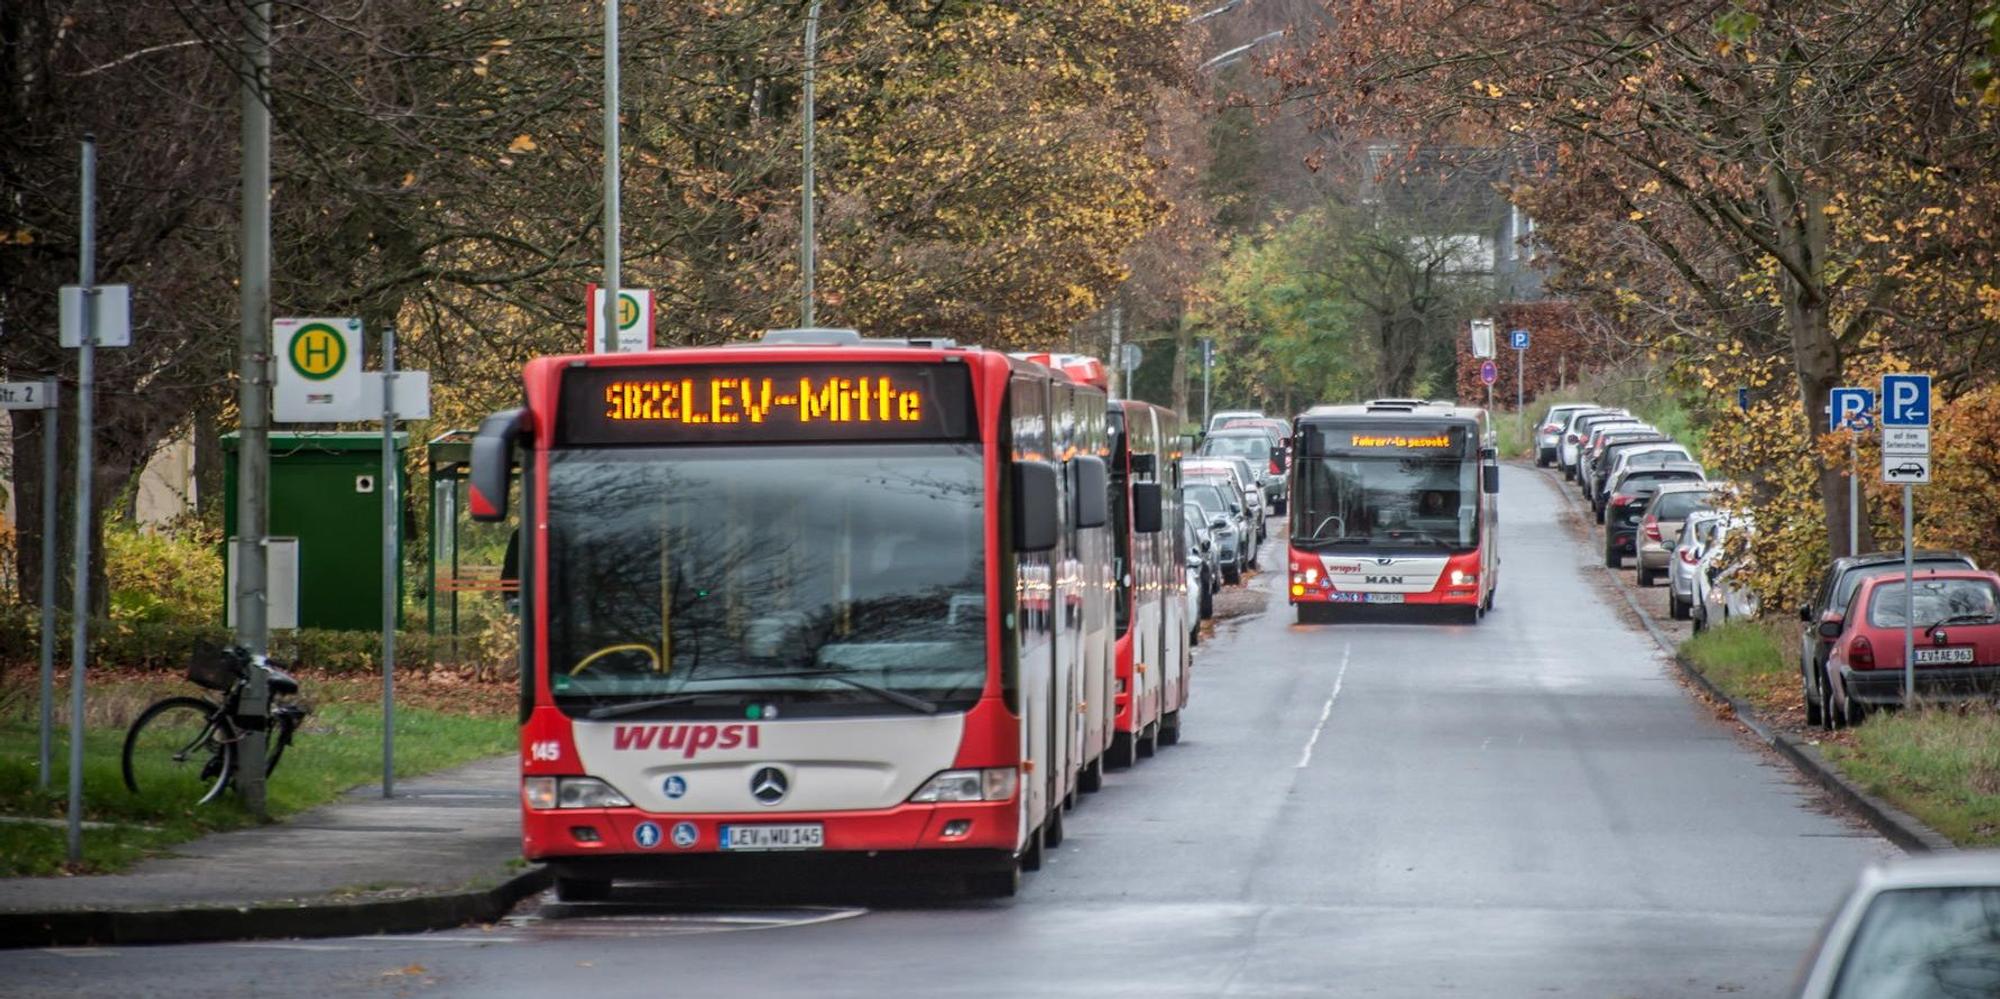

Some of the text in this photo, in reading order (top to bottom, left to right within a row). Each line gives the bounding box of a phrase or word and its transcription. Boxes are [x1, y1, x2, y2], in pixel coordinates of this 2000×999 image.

[1515, 333, 1526, 347] P
[306, 336, 330, 368] H
[24, 386, 34, 402] 2
[606, 376, 922, 424] SB22 LEV-Mitte
[1893, 381, 1920, 420] P
[1841, 393, 1865, 428] P
[1329, 563, 1361, 574] wupsi
[1365, 575, 1404, 585] MAN
[1954, 649, 1972, 661] 963
[613, 724, 760, 759] wupsi
[531, 742, 560, 761] 145
[730, 827, 820, 846] LEV WU 145
